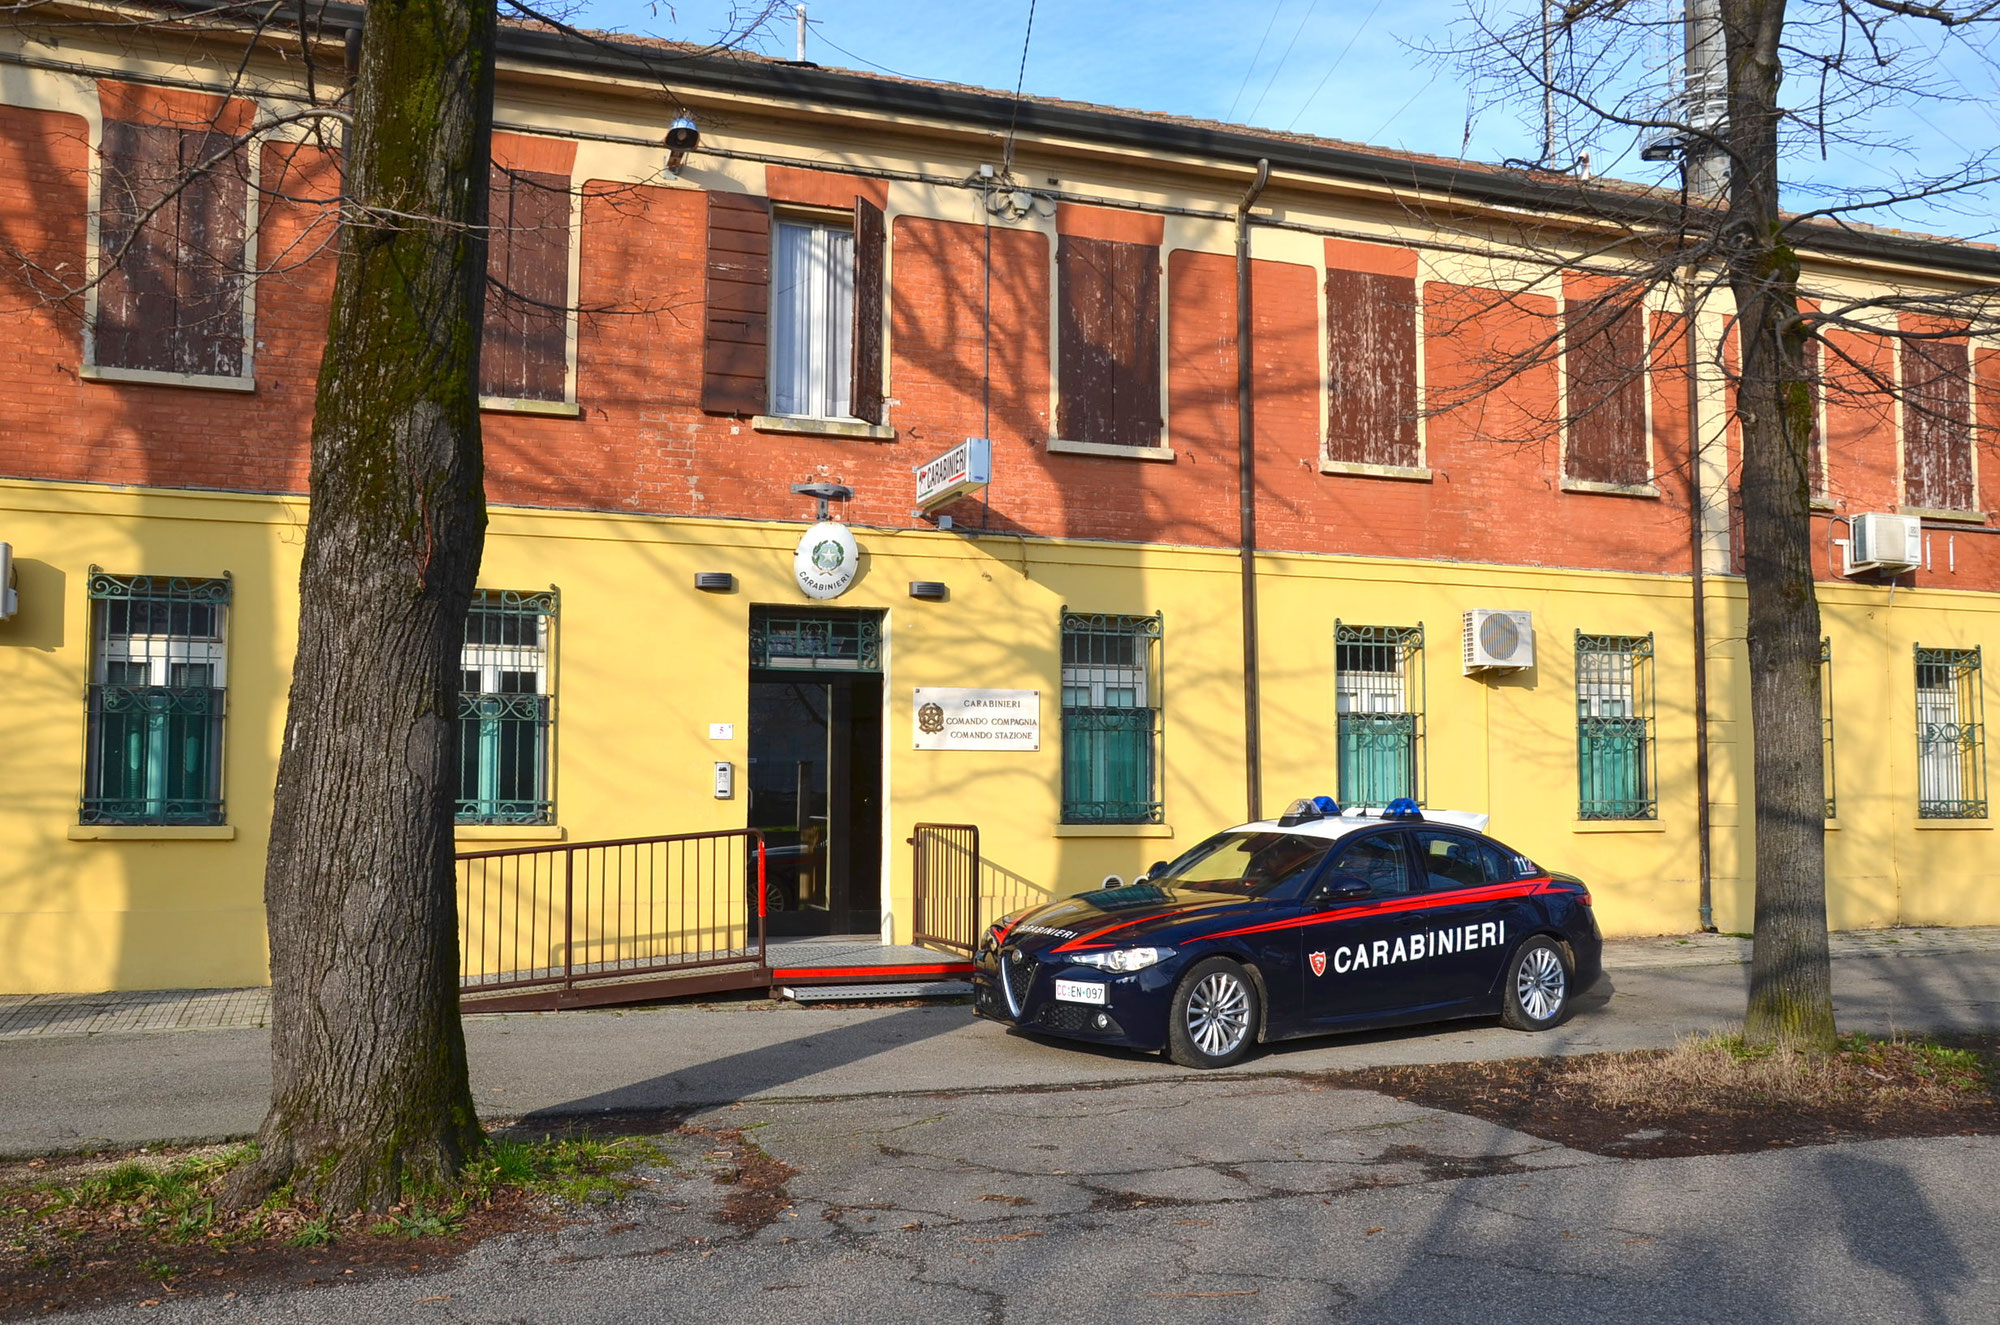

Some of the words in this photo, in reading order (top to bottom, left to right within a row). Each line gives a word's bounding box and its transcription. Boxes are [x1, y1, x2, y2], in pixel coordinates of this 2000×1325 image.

[927, 447, 966, 489] CARABINIERI
[799, 571, 850, 591] CARABINIERI
[963, 700, 1021, 708] CARABINIERI
[946, 717, 988, 725] COMANDO
[991, 718, 1037, 726] COMPAGNIA
[950, 731, 992, 739] COMANDO
[995, 732, 1032, 740] STAZIONE
[1334, 920, 1505, 974] CARABINIERI
